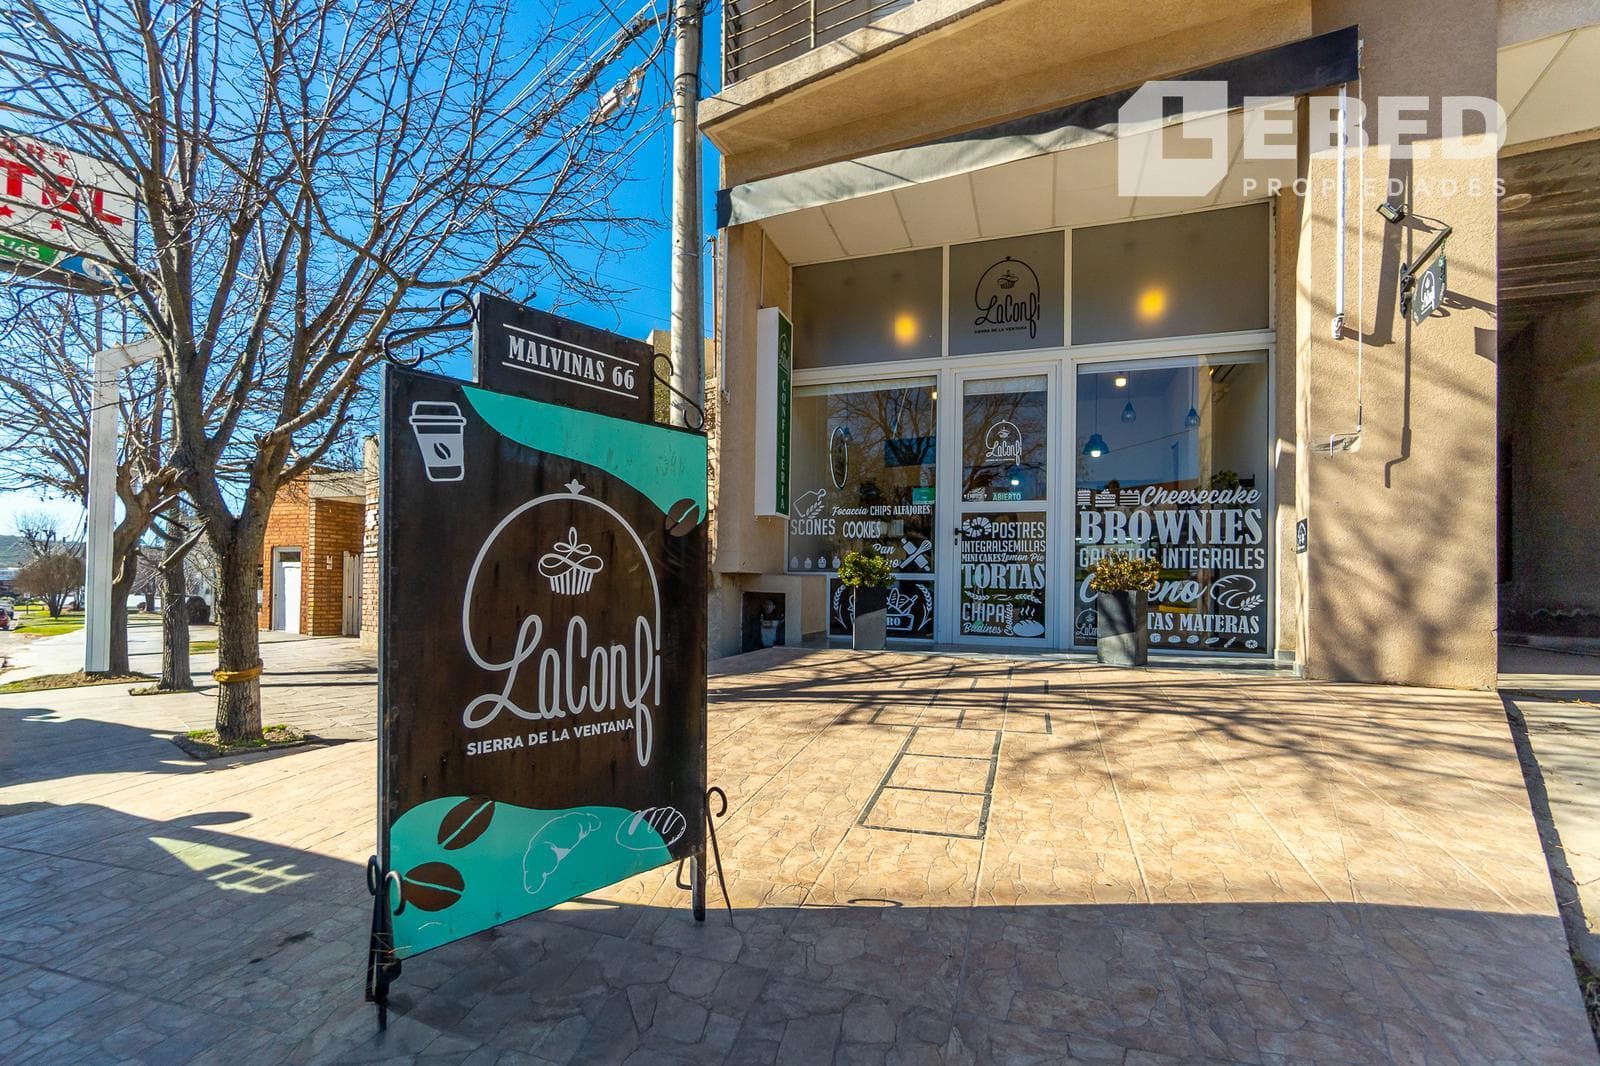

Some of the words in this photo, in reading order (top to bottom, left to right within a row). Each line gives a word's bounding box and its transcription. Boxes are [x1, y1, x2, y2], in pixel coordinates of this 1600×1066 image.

[508, 334, 605, 383] MALVINAS
[611, 365, 636, 391] 66
[992, 492, 1022, 501] ABIERTO
[1140, 485, 1263, 507] Cheesecake
[831, 506, 869, 517] Focaccia
[869, 505, 892, 516] CHIPS
[892, 504, 932, 516] ALFAJORES
[790, 518, 836, 536] SCONES
[842, 520, 881, 539] COOKIES
[991, 521, 1045, 539] POSTRES
[1079, 508, 1263, 545] BROWNIES
[961, 553, 978, 563] MINI
[979, 553, 1001, 563] CAKES
[1001, 552, 1029, 563] Lemon
[1029, 552, 1045, 563] Pie
[1162, 547, 1265, 570] INTEGRALES
[961, 563, 1046, 590] TORTAS
[962, 602, 1005, 623] CHIPA
[1179, 613, 1260, 634] MATERAS
[462, 614, 662, 768] LaConfi
[466, 734, 524, 756] SIERRA
[528, 730, 548, 749] DE
[551, 727, 570, 743] LA
[573, 717, 635, 739] VENTANA
